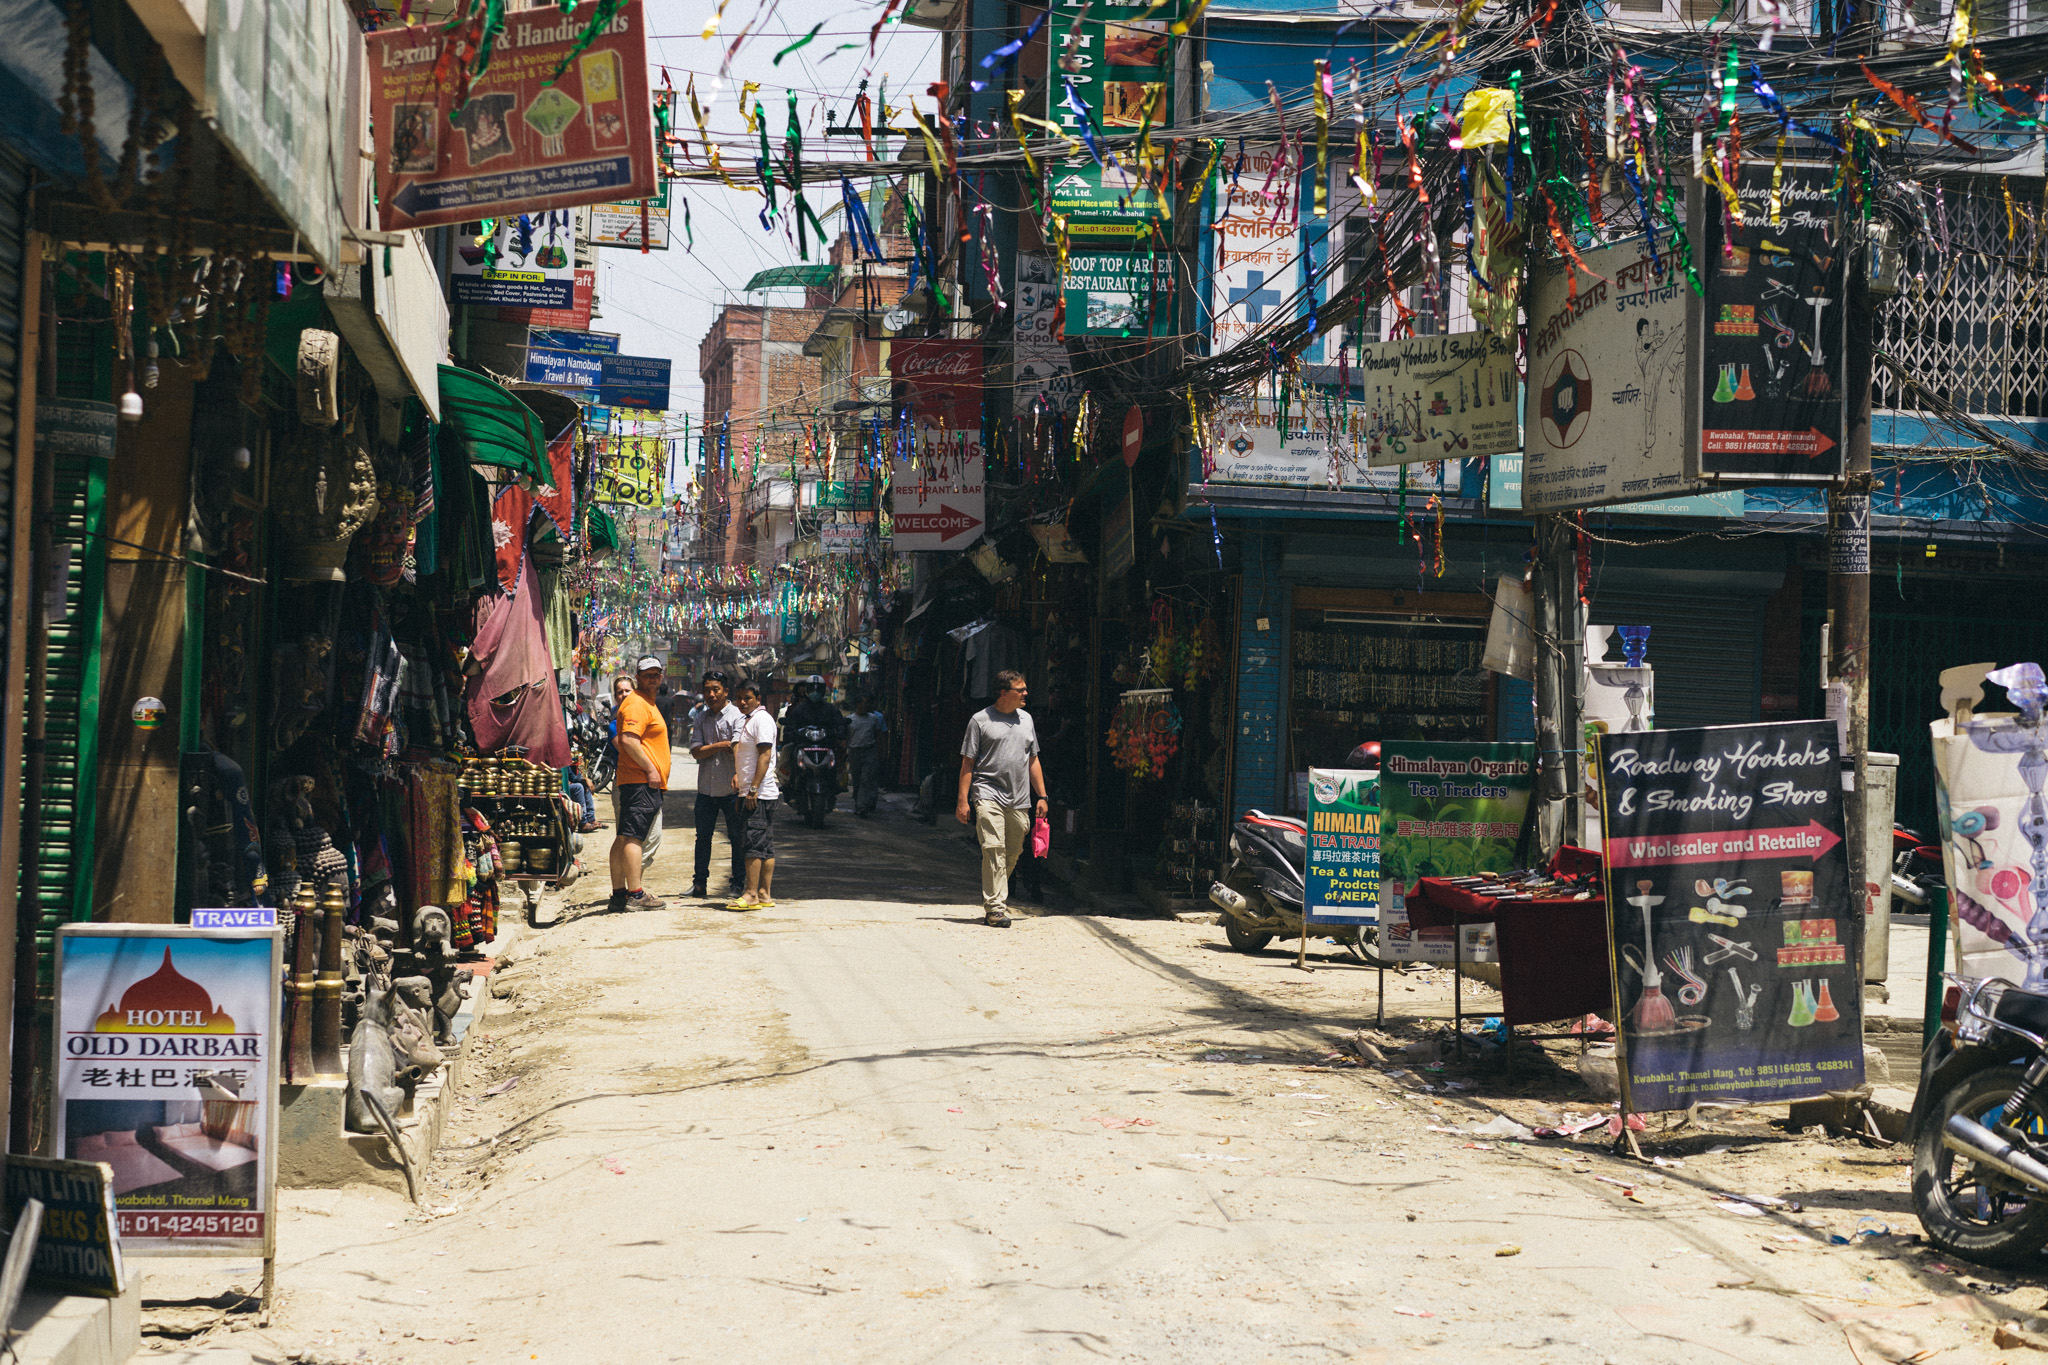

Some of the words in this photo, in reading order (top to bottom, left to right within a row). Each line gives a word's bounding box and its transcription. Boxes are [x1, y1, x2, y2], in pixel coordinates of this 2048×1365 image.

[1055, 189, 1073, 197] Pvt.
[1075, 189, 1092, 197] Ltd.
[619, 206, 637, 214] TIBET
[1080, 200, 1098, 208] Place
[1099, 200, 1113, 208] with
[1099, 257, 1123, 272] TOP
[510, 272, 519, 280] IN
[521, 273, 541, 281] FOR:
[1062, 276, 1138, 291] RESTAURANT
[530, 352, 566, 368] Himalayan
[1362, 348, 1401, 377] Roadway
[1401, 342, 1438, 374] Hookahs
[1440, 338, 1448, 362] &
[545, 369, 565, 382] Travel
[567, 371, 573, 384] &
[574, 373, 593, 386] Treks
[1776, 432, 1816, 442] Kathmandu
[1707, 442, 1724, 450] Cell:
[1786, 443, 1818, 452] 4268341
[962, 485, 982, 494] BAR
[897, 517, 971, 529] WELCOME
[1831, 536, 1866, 546] Fridge
[1388, 756, 1466, 779] Himalayan
[1470, 757, 1529, 779] Organic
[1609, 747, 1722, 784] Roadway
[1723, 738, 1831, 779] Hookahs
[1408, 781, 1438, 797] Tea
[1442, 782, 1508, 798] Traders
[1618, 786, 1638, 817] &
[1645, 781, 1753, 820] Smoking
[1761, 780, 1829, 807] Store
[1397, 821, 1520, 838] 喜马拉雅茶贸易商
[1311, 834, 1338, 848] TEA
[1629, 839, 1719, 860] Wholesaler
[1722, 835, 1754, 854] and
[1758, 831, 1823, 852] Retailer
[1310, 866, 1335, 877] Tea
[1338, 867, 1349, 877] &
[1330, 879, 1380, 891] Prodcts
[1324, 891, 1339, 901] of
[195, 911, 271, 926] TRAVEL
[126, 1009, 208, 1027] HOTEL
[67, 1036, 129, 1056] OLD
[139, 1036, 262, 1057] DARBAR
[1678, 1068, 1711, 1081] Thamel
[1738, 1066, 1755, 1077] Tel:
[1815, 1059, 1854, 1071] 4268341
[1668, 1083, 1699, 1094] E-mail:
[1700, 1075, 1822, 1093] roadwayhookahs@gmail.com
[114, 1194, 169, 1208] wabahal,
[172, 1193, 216, 1206] Thamel
[217, 1195, 249, 1208] Marg
[135, 1215, 258, 1233] 01-4245120
